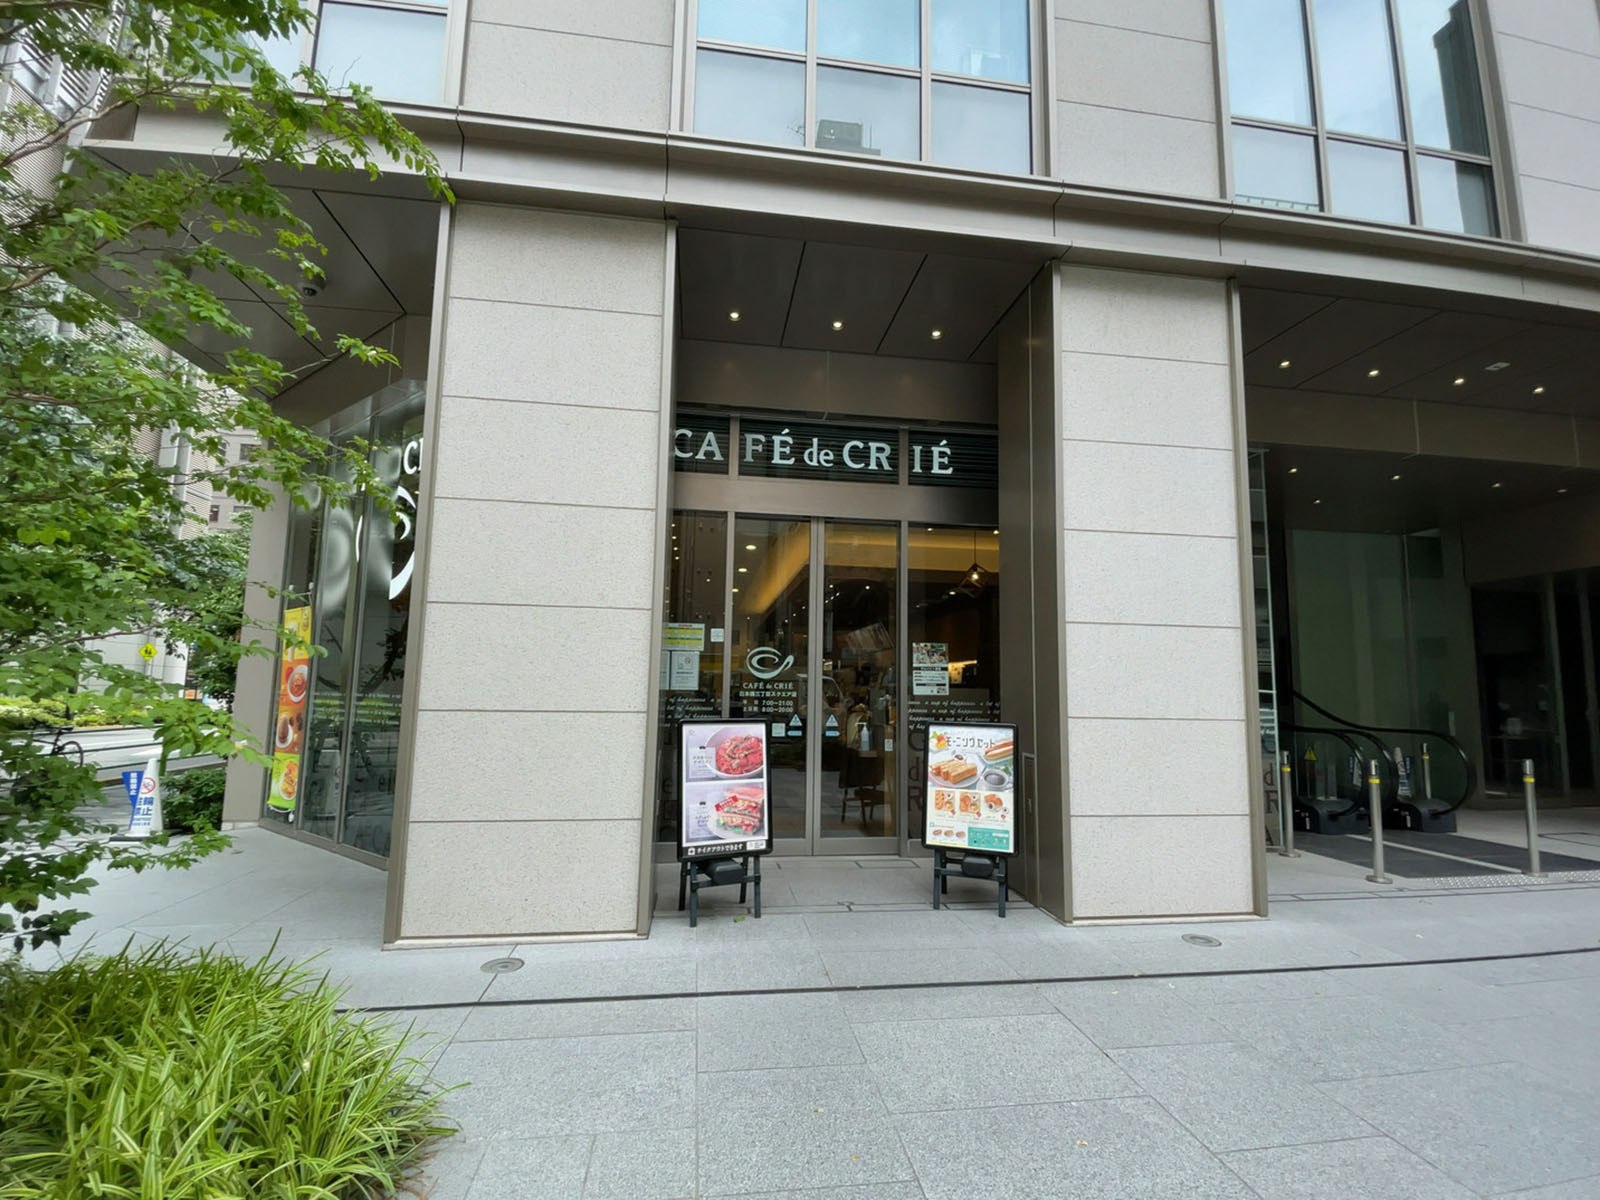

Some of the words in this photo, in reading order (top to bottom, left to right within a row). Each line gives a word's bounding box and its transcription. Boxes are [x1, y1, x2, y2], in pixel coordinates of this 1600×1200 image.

[674, 428, 795, 465] CAFÉ
[804, 438, 834, 467] de
[842, 440, 953, 475] CRIÉ
[743, 681, 764, 690] CAFÉ
[774, 681, 794, 690] CRIÉ
[946, 735, 996, 749] モーニングセット
